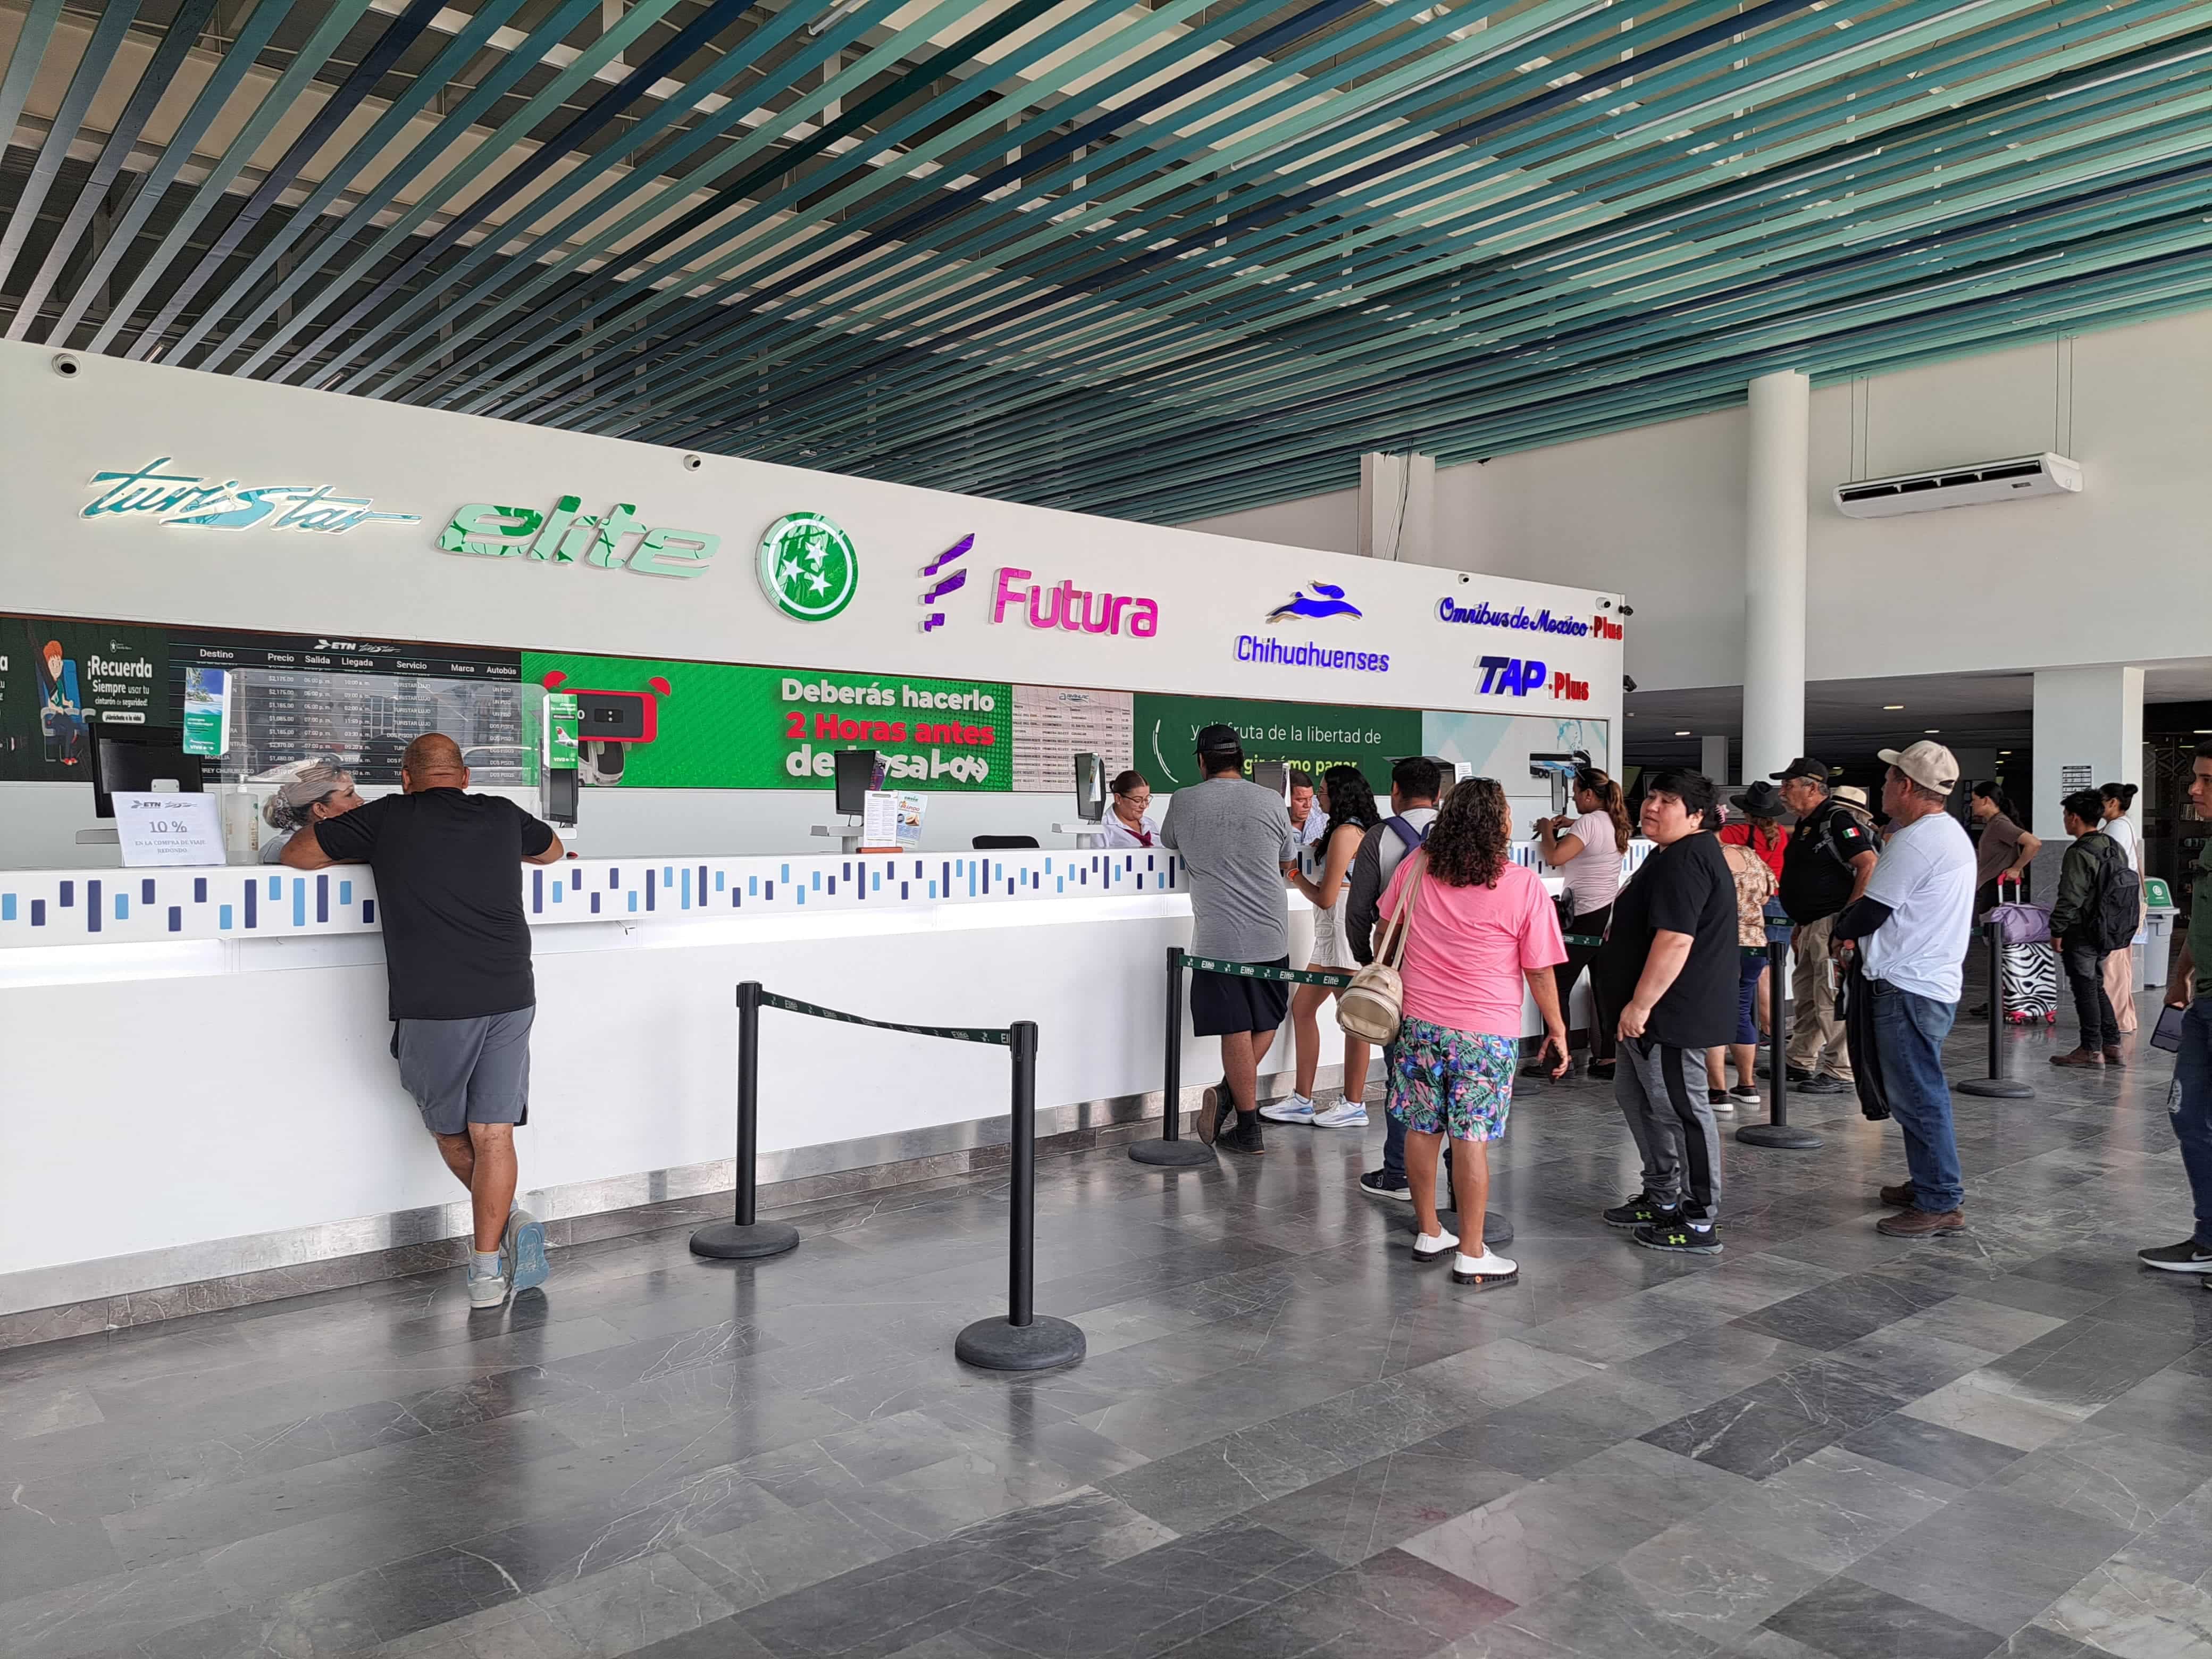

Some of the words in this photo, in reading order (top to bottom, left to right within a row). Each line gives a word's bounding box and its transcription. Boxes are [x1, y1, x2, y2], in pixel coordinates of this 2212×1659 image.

[433, 495, 721, 579] elite
[990, 567, 1158, 638] Futura
[1437, 597, 1510, 627] Omnibus
[1510, 606, 1530, 630] de
[331, 642, 356, 650] ETN
[1234, 635, 1390, 672] Chihuahuenses
[87, 655, 153, 680] ¡Recuerda
[200, 649, 234, 659] Destino
[267, 653, 295, 662] Precio
[305, 655, 331, 665] Salida
[341, 657, 373, 667] Llegada
[396, 660, 427, 670] Servicio
[451, 664, 475, 673] Marca
[486, 666, 517, 675] Autobús
[93, 679, 127, 697] Siempre
[143, 685, 149, 694] tu
[1476, 655, 1546, 697] TAP
[1553, 672, 1589, 701] Plus
[95, 696, 116, 705] cinturón
[781, 678, 896, 706] Deberás
[902, 684, 994, 711] hacerlo
[785, 711, 806, 739] 2
[815, 713, 907, 742] Horas
[915, 720, 995, 745] antes
[1191, 724, 1200, 741] y
[1268, 725, 1287, 741] de
[1291, 725, 1303, 741] la
[1307, 725, 1361, 743] libertad
[1364, 728, 1381, 744] de
[786, 744, 835, 777] de
[149, 820, 167, 833] 10
[172, 820, 188, 833] %
[1201, 960, 1215, 969] Elite
[1240, 966, 1254, 975] Elite
[1279, 971, 1295, 980] Elite
[1323, 976, 1339, 985] Elite
